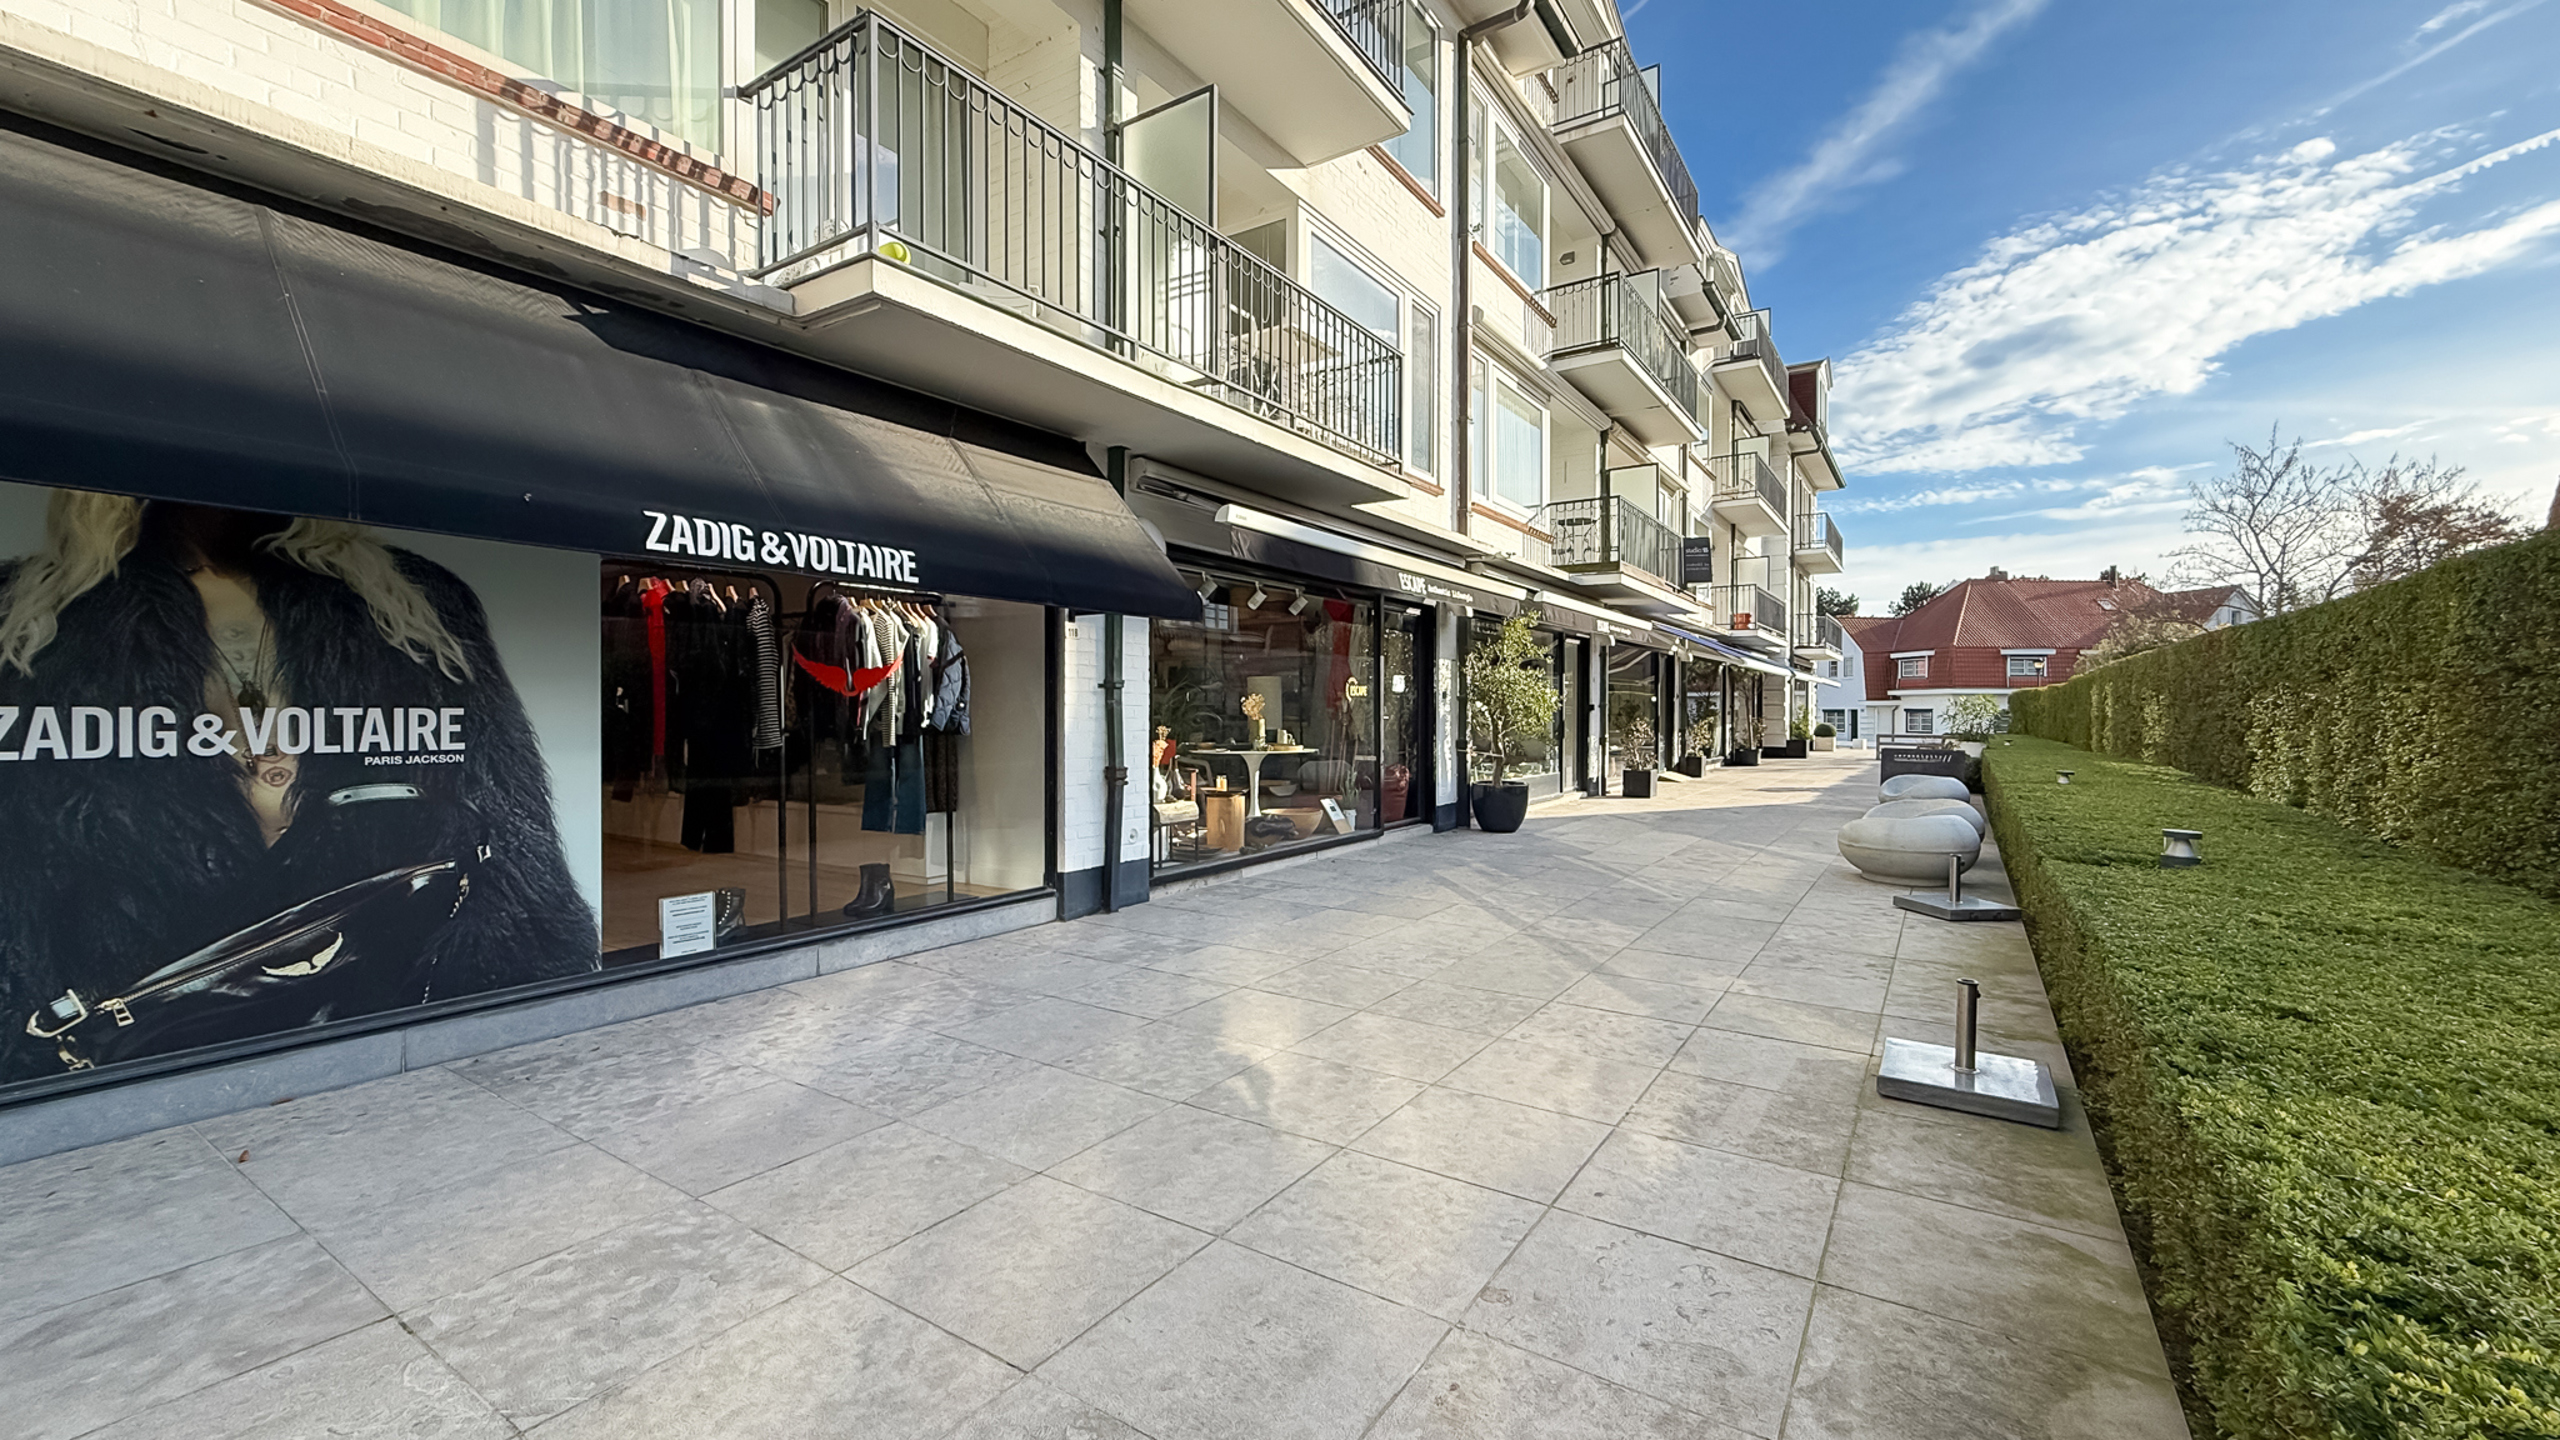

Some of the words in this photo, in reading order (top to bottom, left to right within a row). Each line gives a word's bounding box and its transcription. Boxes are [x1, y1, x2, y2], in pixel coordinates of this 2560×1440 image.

[643, 510, 756, 562] ZADIG
[760, 531, 790, 566] &
[783, 531, 919, 583] VOLTAIRE
[1398, 572, 1427, 595] ESCAPE
[187, 713, 239, 757] &
[238, 706, 466, 756] VOLTAIRE
[364, 755, 403, 766] PARIS
[405, 753, 465, 765] JACKSON
